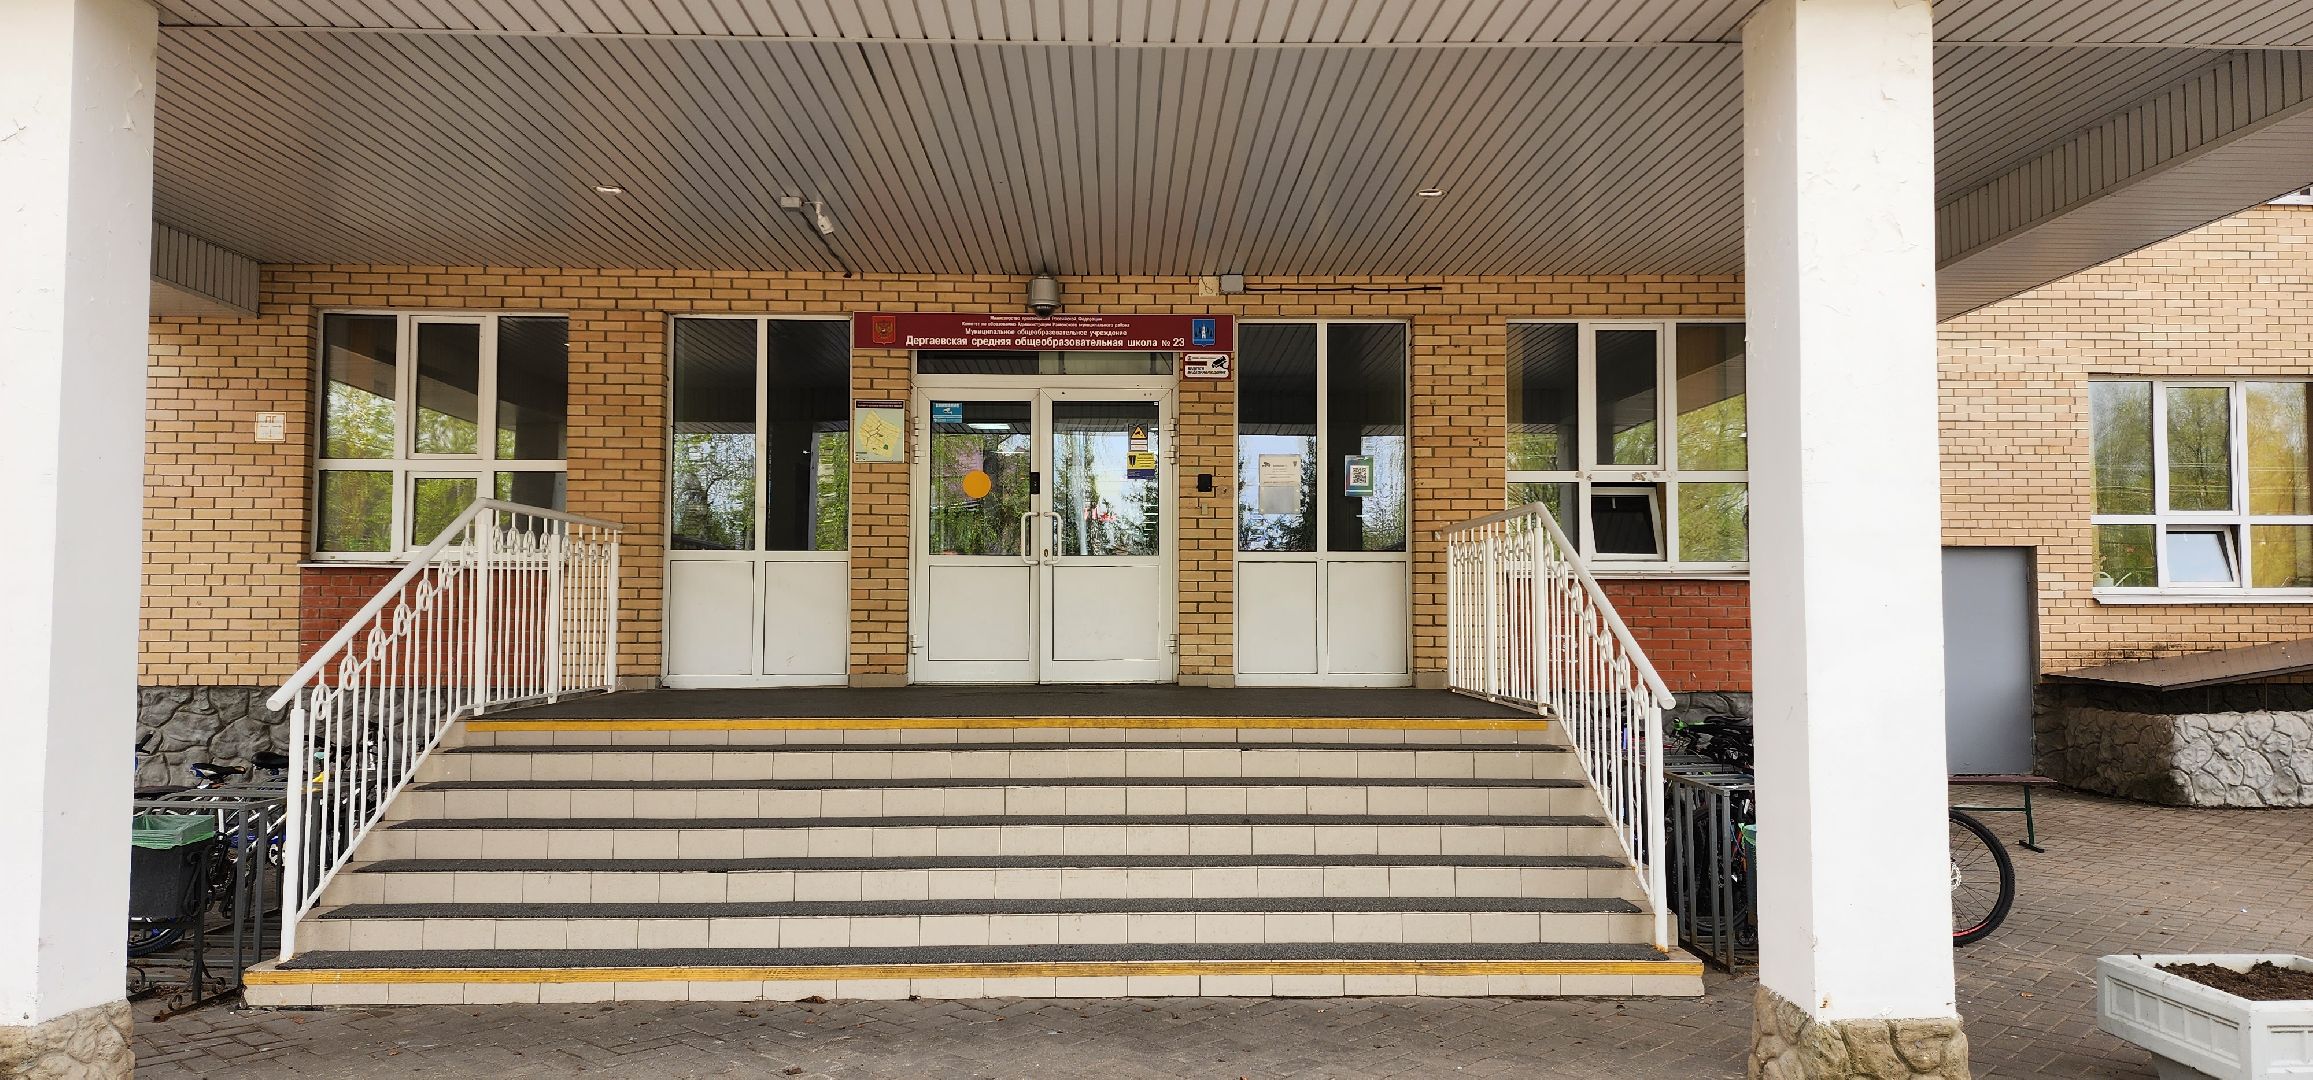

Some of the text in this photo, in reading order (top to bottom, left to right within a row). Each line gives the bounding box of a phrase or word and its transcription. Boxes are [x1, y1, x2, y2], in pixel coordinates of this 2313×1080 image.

[965, 327, 1128, 338] Муниципальное общеобразовательное учреждение
[906, 335, 968, 346] Дергаевская
[971, 337, 1011, 347] средняя
[1015, 337, 1123, 348] общеобразовательная
[1127, 339, 1158, 347] школа
[1172, 338, 1185, 347] 23
